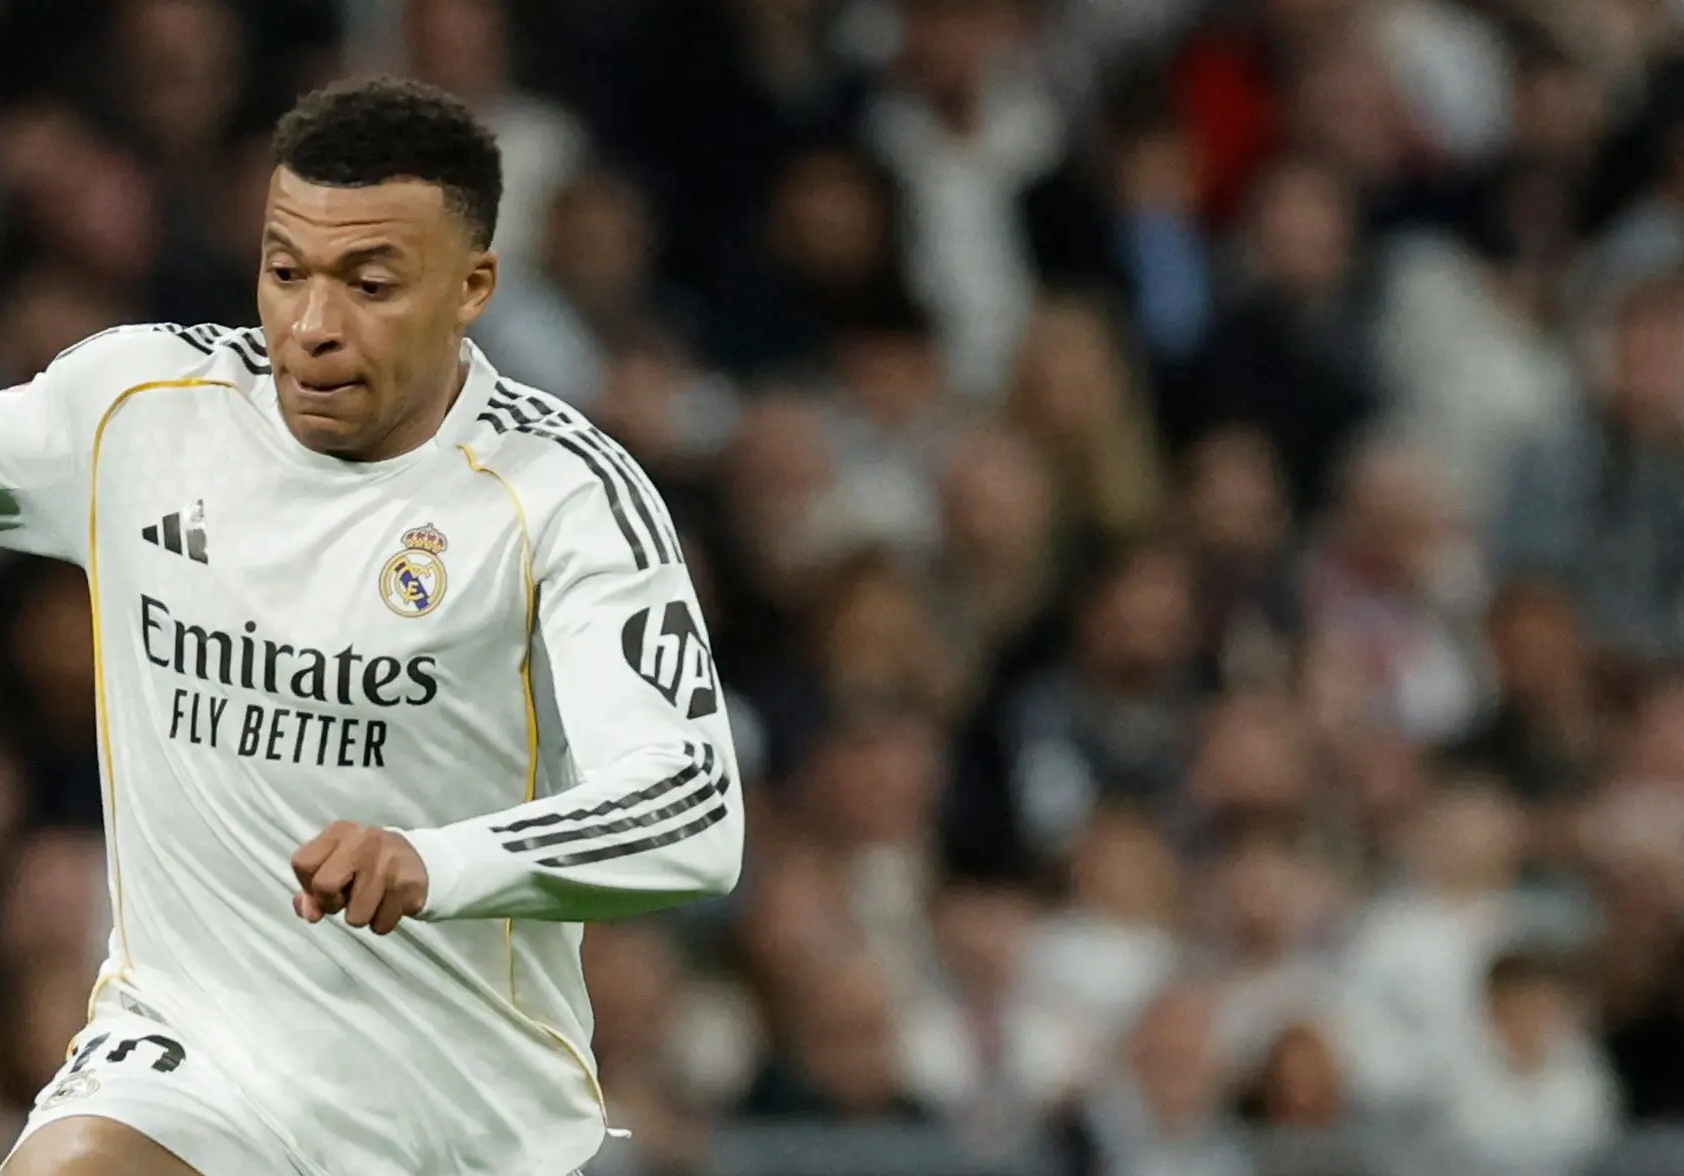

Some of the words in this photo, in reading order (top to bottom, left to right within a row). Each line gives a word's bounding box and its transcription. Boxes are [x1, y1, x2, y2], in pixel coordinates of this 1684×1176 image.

[140, 593, 438, 707] Emirates
[169, 688, 228, 748] FLY
[237, 704, 387, 767] BETTER
